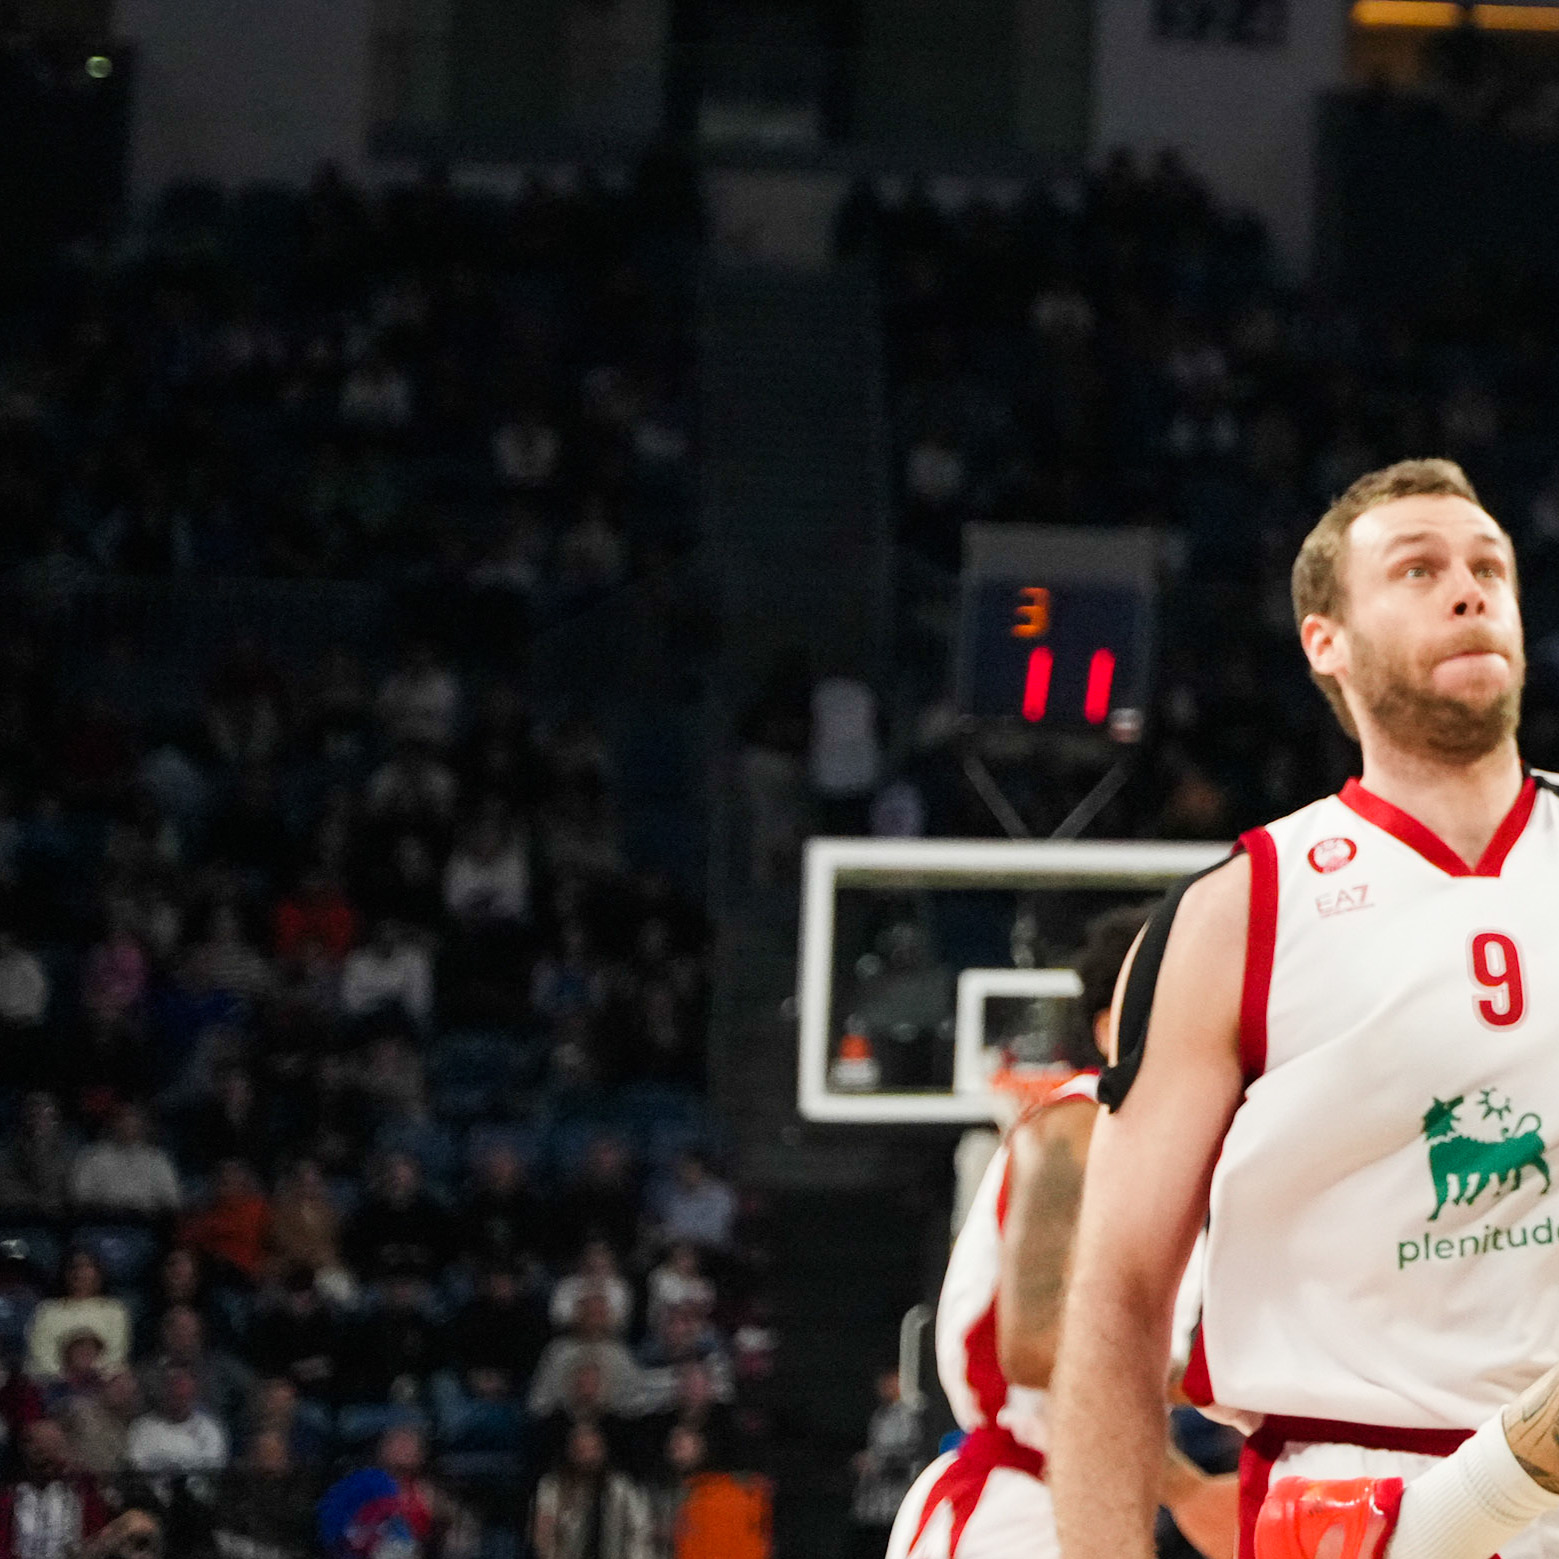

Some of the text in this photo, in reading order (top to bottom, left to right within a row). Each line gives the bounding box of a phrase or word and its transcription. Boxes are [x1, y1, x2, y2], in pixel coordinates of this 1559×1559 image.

[1010, 586, 1051, 638] 3
[1021, 645, 1116, 725] 11
[1315, 884, 1369, 914] EA7
[1468, 929, 1527, 1030] 9
